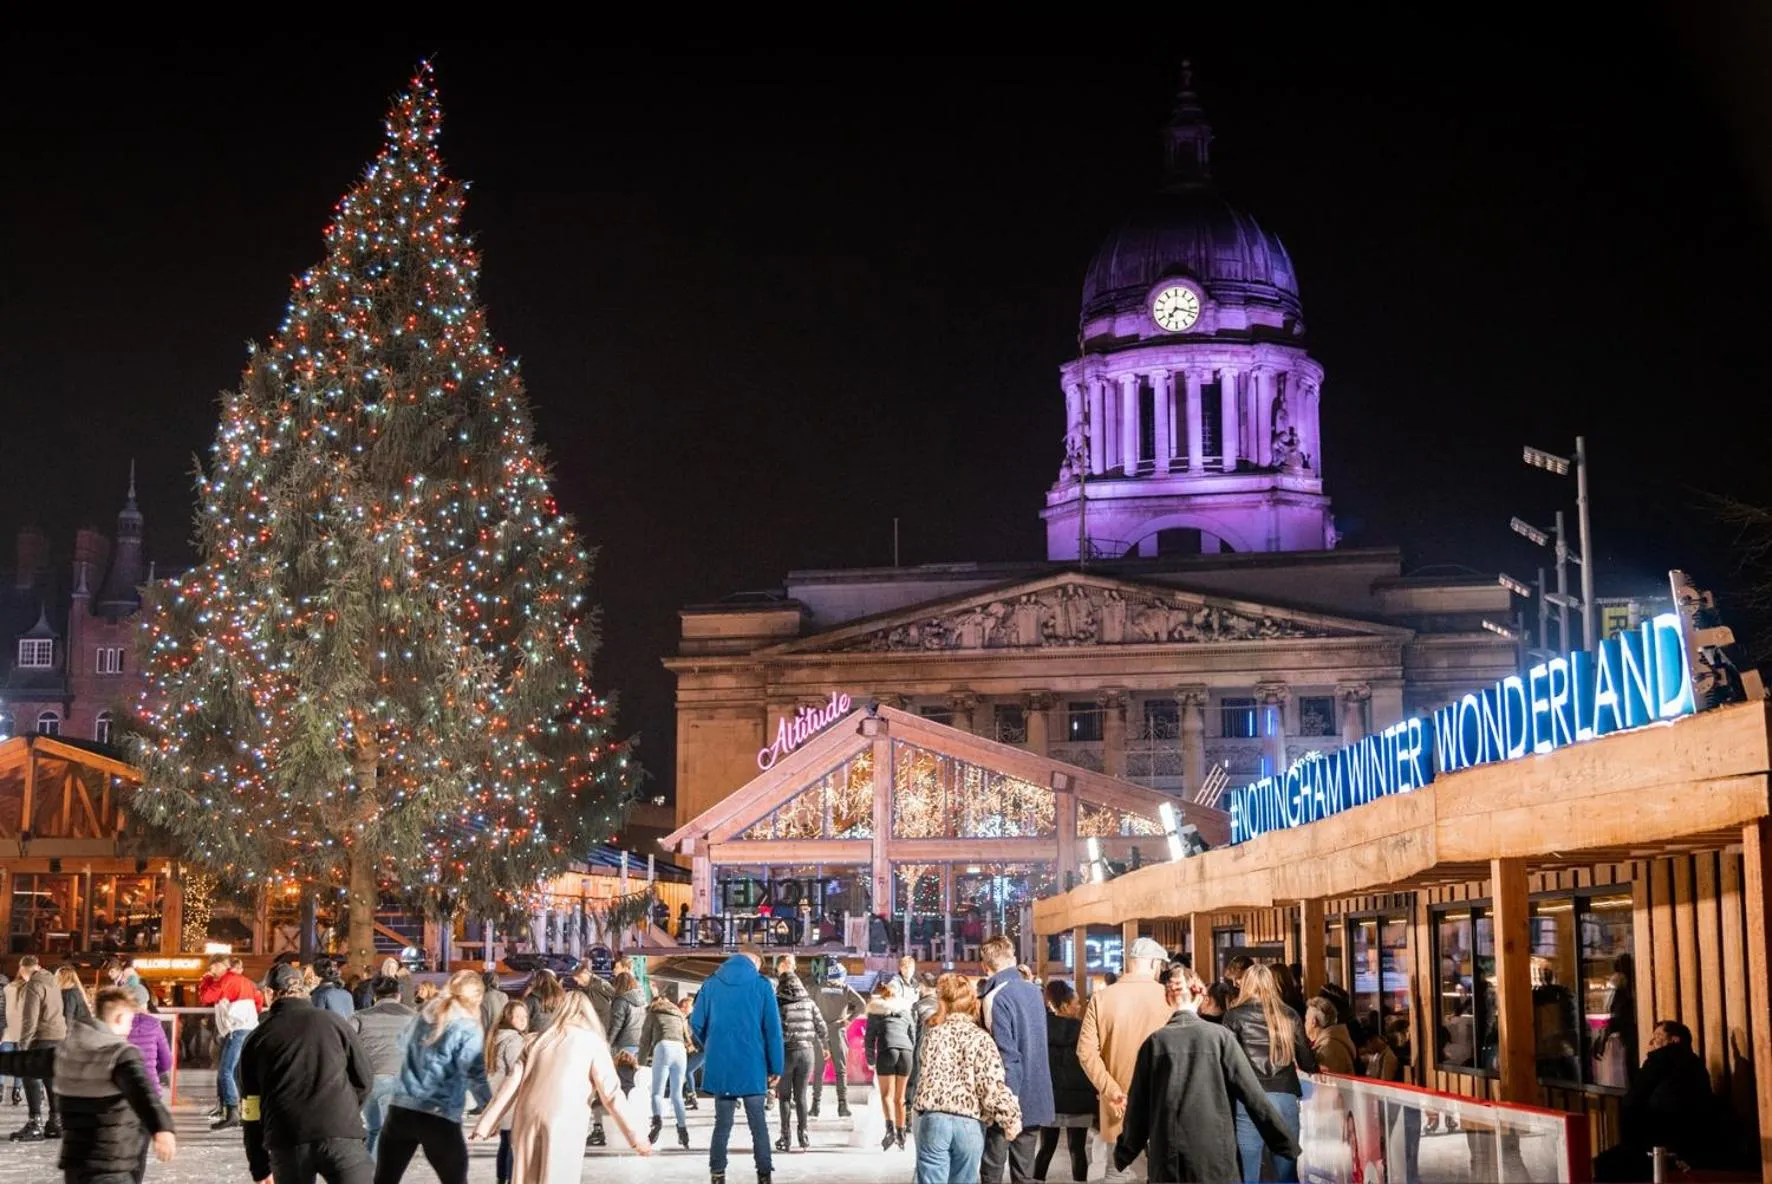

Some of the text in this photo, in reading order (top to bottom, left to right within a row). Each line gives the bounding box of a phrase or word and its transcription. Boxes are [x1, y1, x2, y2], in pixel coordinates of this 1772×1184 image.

[757, 691, 851, 770] Altitude
[1230, 613, 1696, 844] #NOTTINGHAM WINTER WONDERLAND
